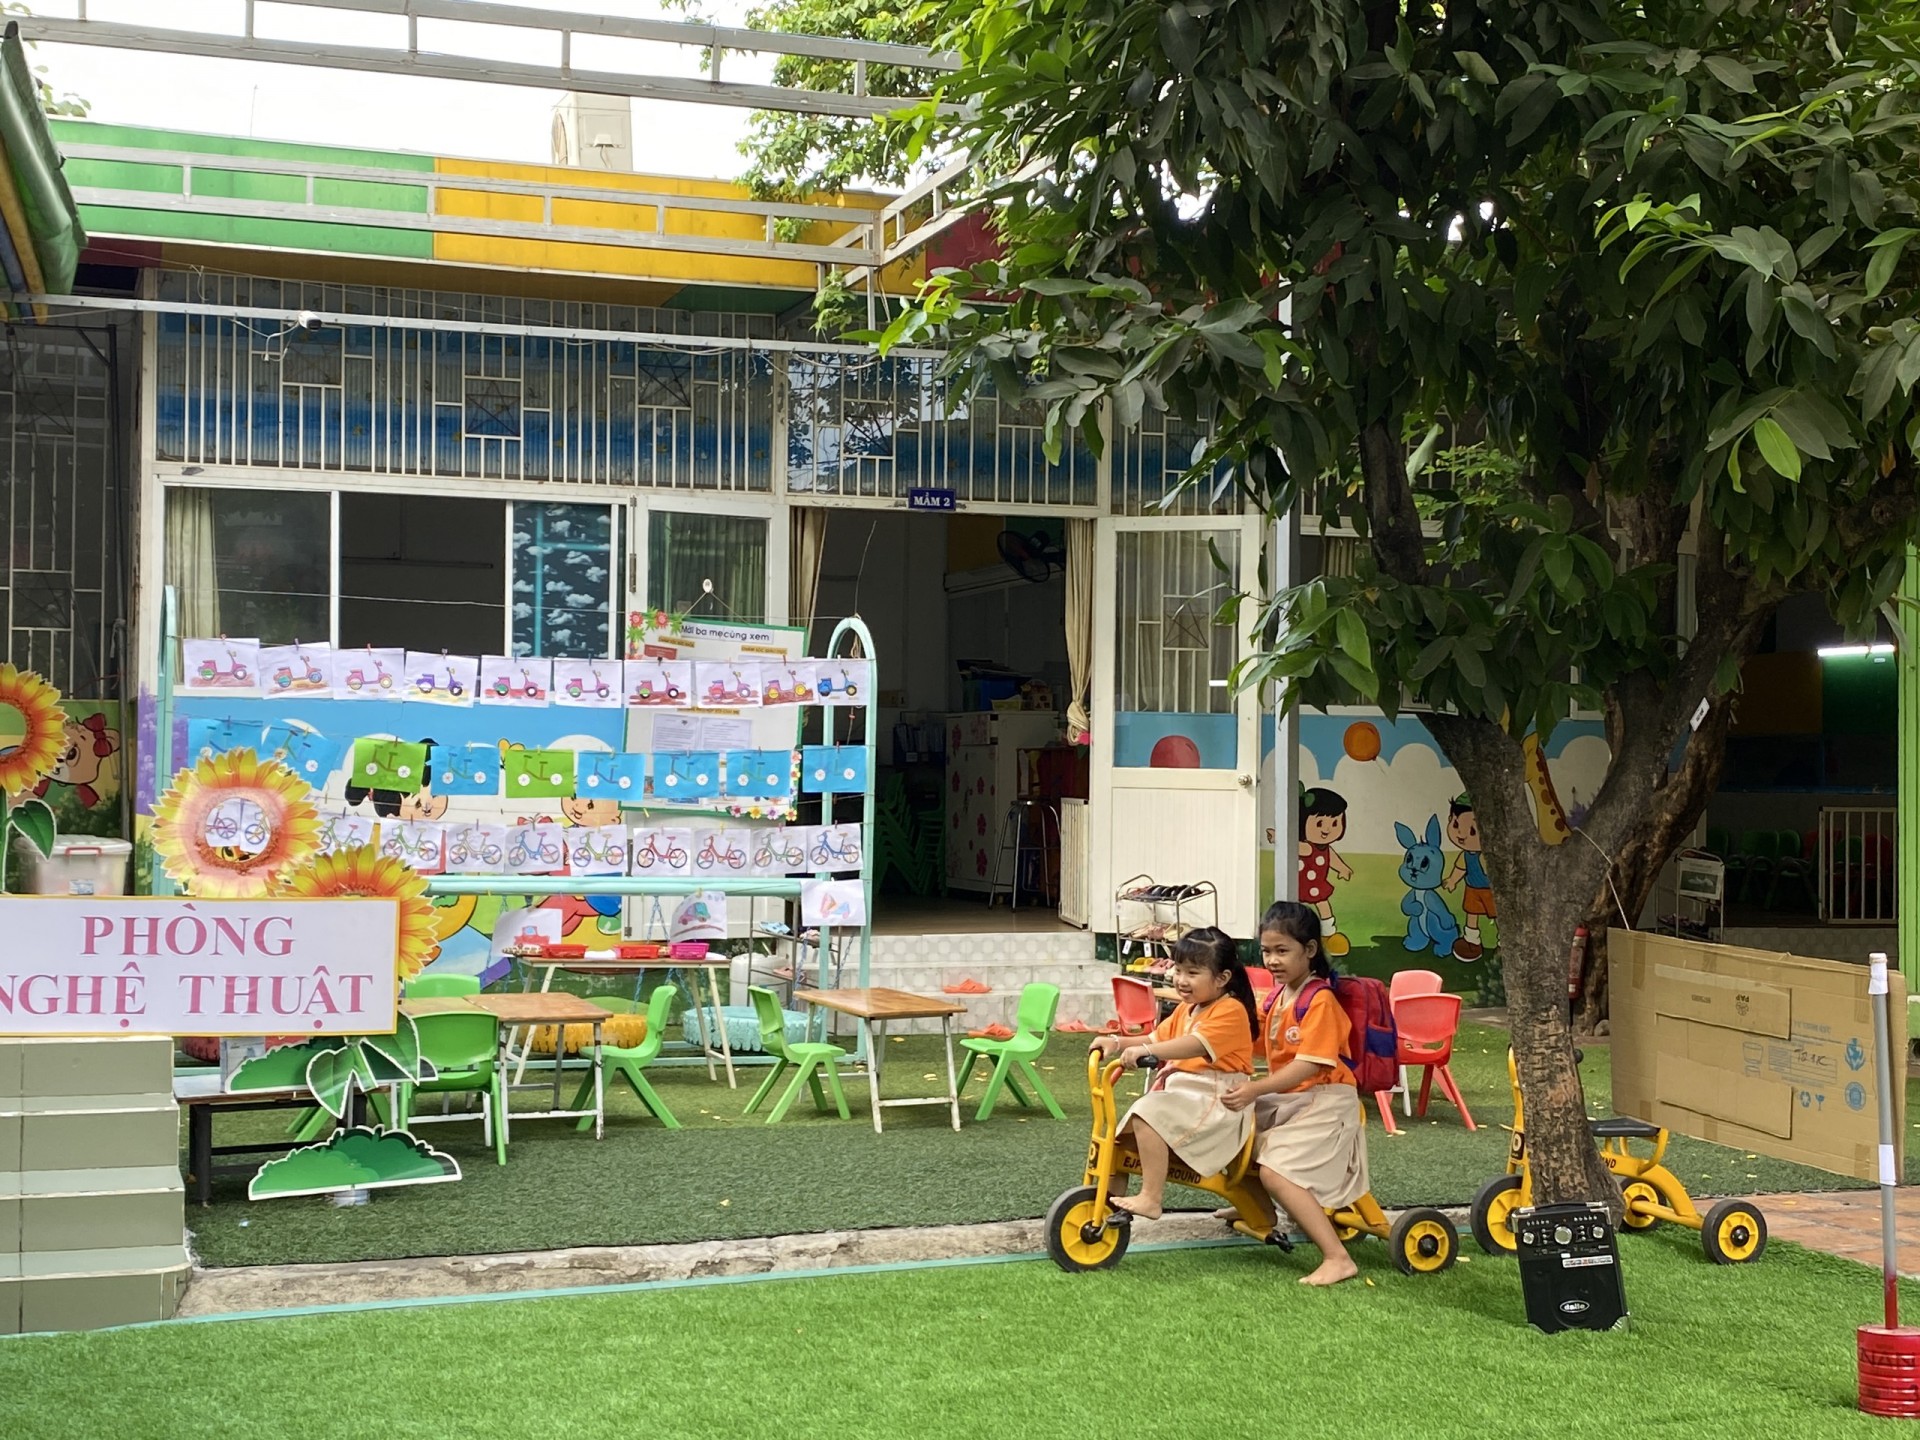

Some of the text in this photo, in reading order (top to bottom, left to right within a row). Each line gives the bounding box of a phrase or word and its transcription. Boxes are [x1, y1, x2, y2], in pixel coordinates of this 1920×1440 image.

[943, 497, 951, 507] 2
[695, 626, 707, 636] ba
[749, 633, 770, 641] xem
[81, 903, 295, 956] PHÒNG
[179, 965, 374, 1029] THUẬT
